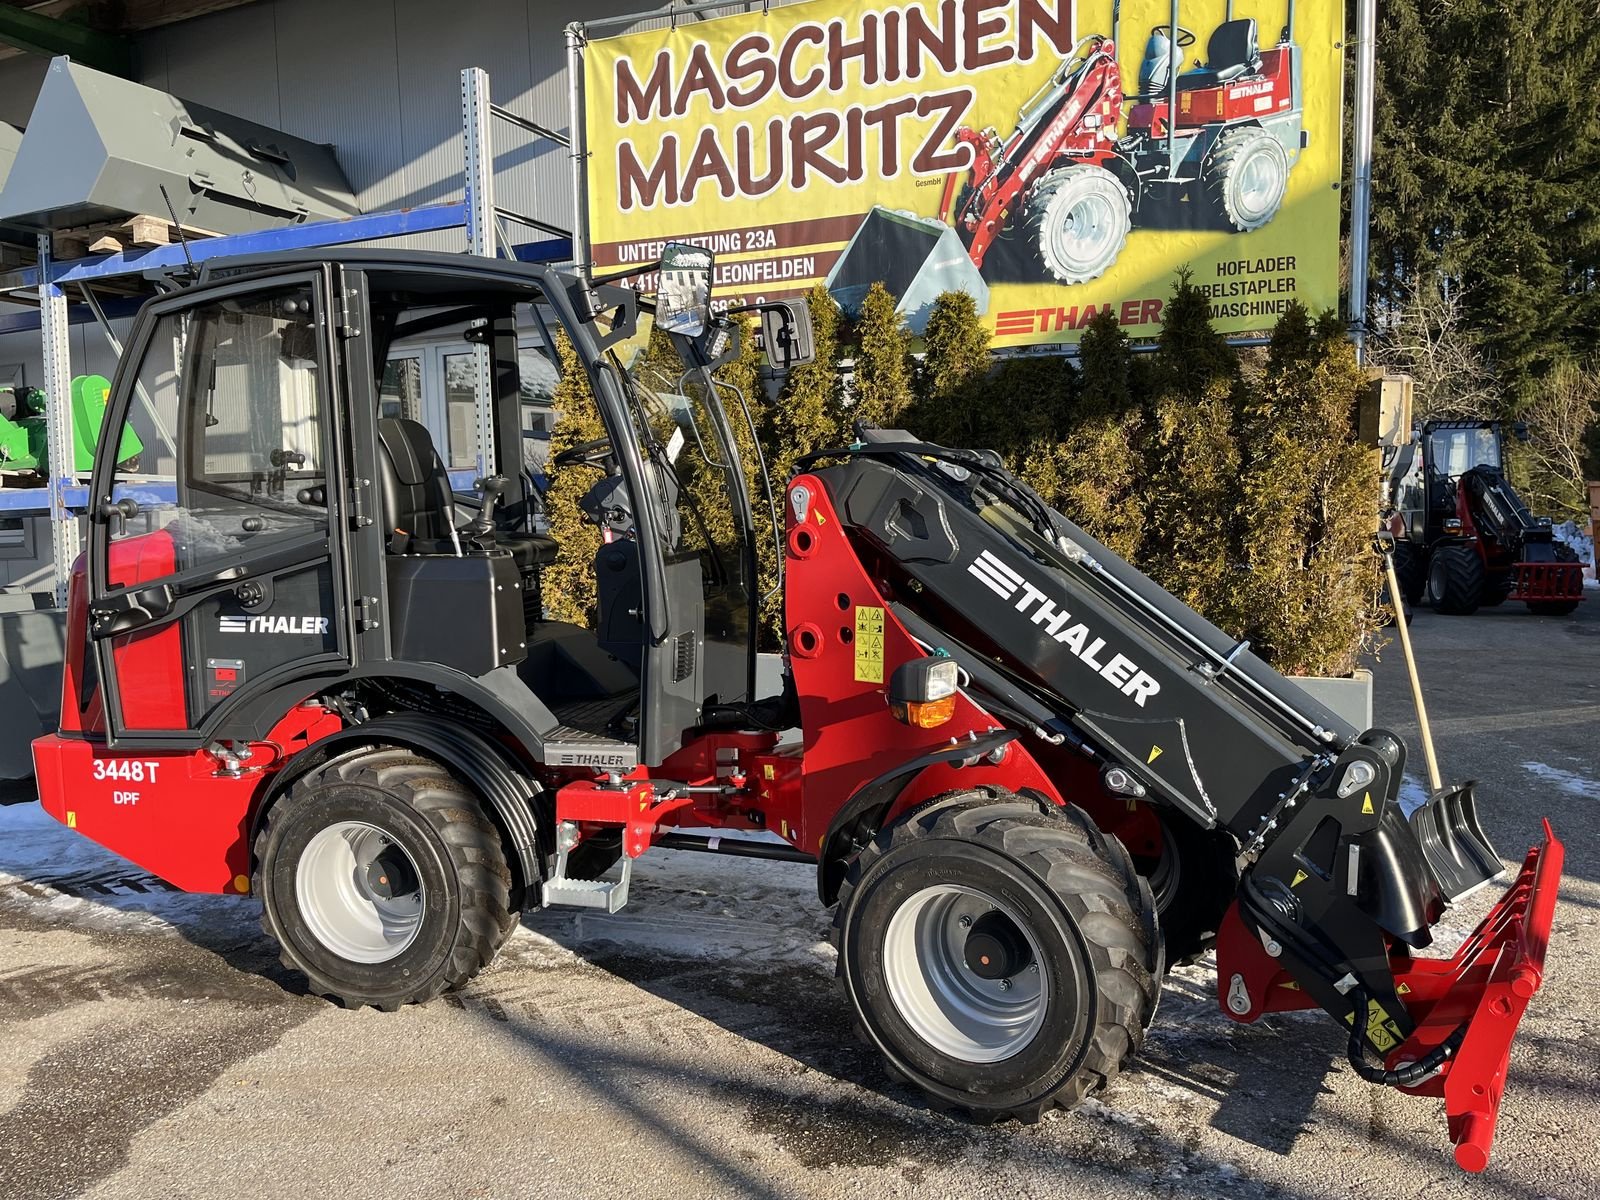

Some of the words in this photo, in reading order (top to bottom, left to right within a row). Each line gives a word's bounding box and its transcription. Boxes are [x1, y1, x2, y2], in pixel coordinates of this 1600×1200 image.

[616, 0, 1073, 124] MASCHINEN
[617, 90, 974, 209] MAURITZ
[915, 177, 942, 188] GesmbH
[745, 229, 777, 250] 23A
[713, 257, 815, 284] LEONFELDEN
[1216, 256, 1296, 277] HOFLADER
[1192, 278, 1296, 299] ABELSTAPLER
[246, 615, 329, 635] THALER
[1014, 581, 1161, 708] THALER
[575, 754, 624, 766] THALER
[113, 791, 140, 806] DPF
